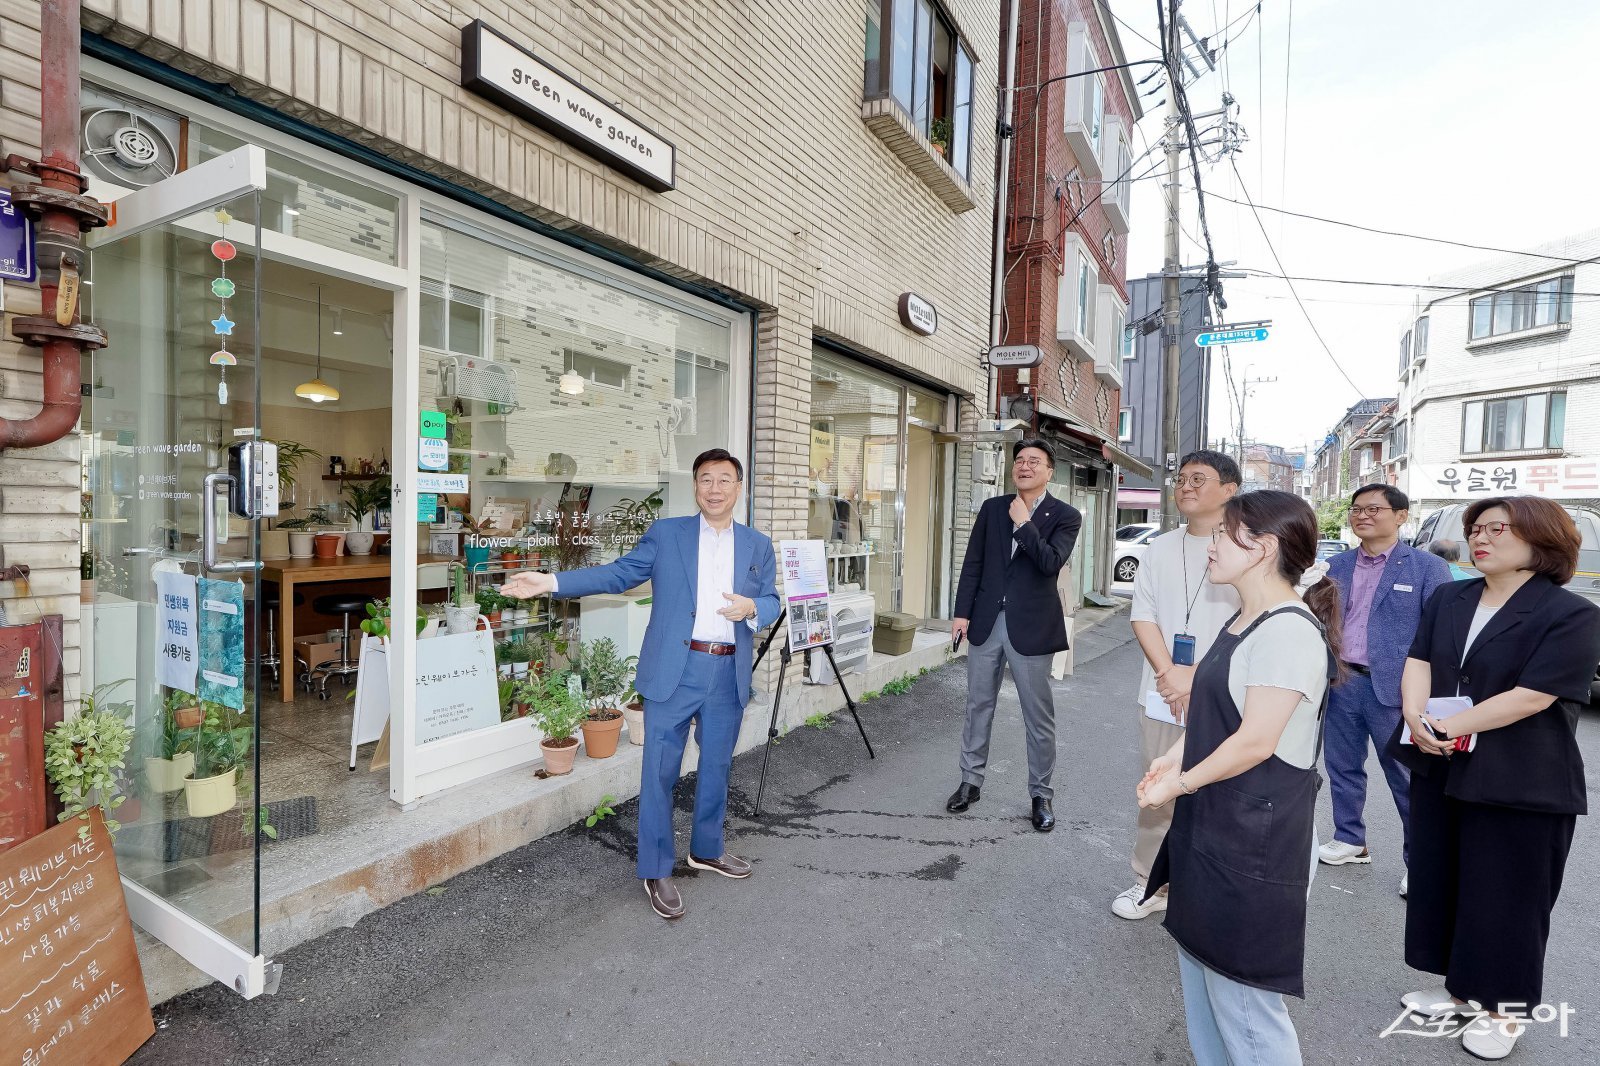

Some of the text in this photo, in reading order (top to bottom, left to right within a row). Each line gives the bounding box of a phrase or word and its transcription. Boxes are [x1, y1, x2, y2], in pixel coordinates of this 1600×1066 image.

[511, 68, 653, 158] green wave garden
[153, 443, 172, 454] wave
[173, 439, 202, 457] garden
[1436, 462, 1599, 494] 우슬원 푸드
[533, 509, 564, 528] 초록빛
[571, 510, 590, 528] 물결
[469, 533, 512, 549] flower
[527, 532, 560, 550] plant
[572, 531, 600, 546] class
[164, 593, 189, 613] 민생회복
[167, 618, 188, 637] 지원금
[162, 642, 191, 662] 사용가능
[22, 915, 81, 963] 사용 가능
[79, 981, 125, 1025] 클래스
